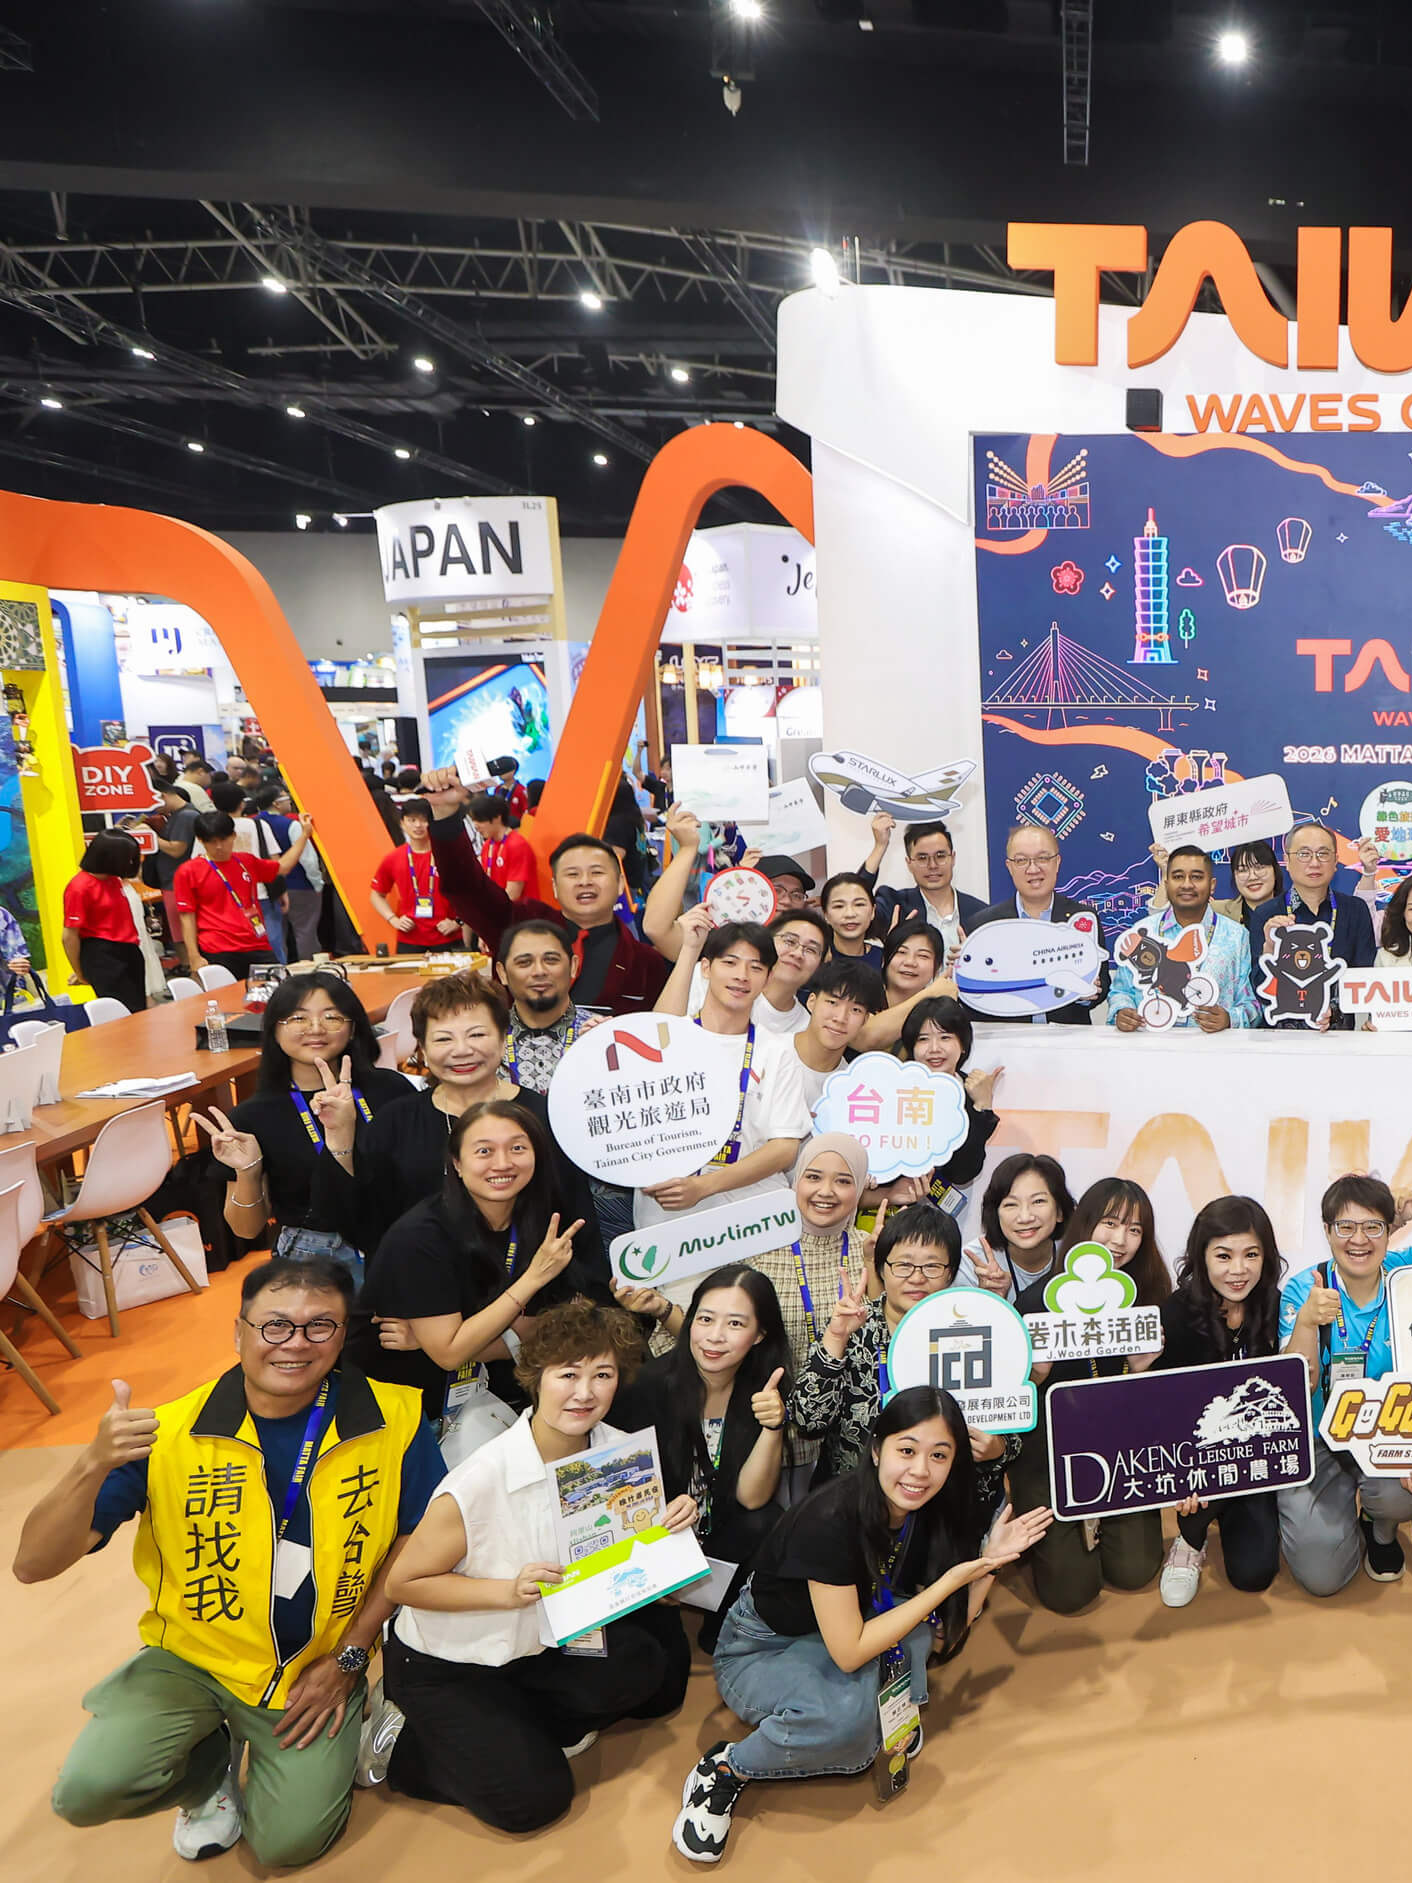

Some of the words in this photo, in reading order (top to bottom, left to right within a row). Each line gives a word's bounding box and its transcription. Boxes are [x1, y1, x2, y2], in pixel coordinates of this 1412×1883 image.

[1186, 393, 1381, 432] WAVES
[1283, 745, 1337, 764] 2026
[81, 765, 133, 784] DIY
[847, 757, 898, 787] STARLUX
[85, 784, 135, 796] ZONE
[1163, 802, 1229, 829] 屏東縣政府
[1198, 814, 1249, 837] 希望城市
[1033, 945, 1056, 957] CHINA
[1376, 1009, 1411, 1018] WAVES
[583, 1071, 706, 1111] 臺南市政府
[847, 1083, 936, 1126] 台南
[587, 1096, 710, 1138] 觀光旅遊局
[606, 1140, 642, 1153] Bureau
[643, 1135, 656, 1145] of
[658, 1128, 702, 1143] Tourism,
[879, 1135, 918, 1149] FUN
[594, 1156, 629, 1169] Tainan
[632, 1151, 653, 1163] City
[656, 1139, 718, 1157] Government
[678, 1209, 796, 1257] MuslimTW
[1046, 1350, 1091, 1360] J.Wood
[1096, 1344, 1142, 1355] Garden
[967, 1413, 1017, 1425] DEVELOPMENT
[1019, 1411, 1031, 1421] LTD
[299, 1440, 314, 1464] MATTA
[1377, 1449, 1401, 1459] FARM
[292, 1463, 307, 1483] FAIR
[1061, 1441, 1193, 1508] DAKENG
[1198, 1444, 1254, 1465] LEISURE
[1263, 1438, 1300, 1456] FARM
[183, 1461, 248, 1623] 請找我
